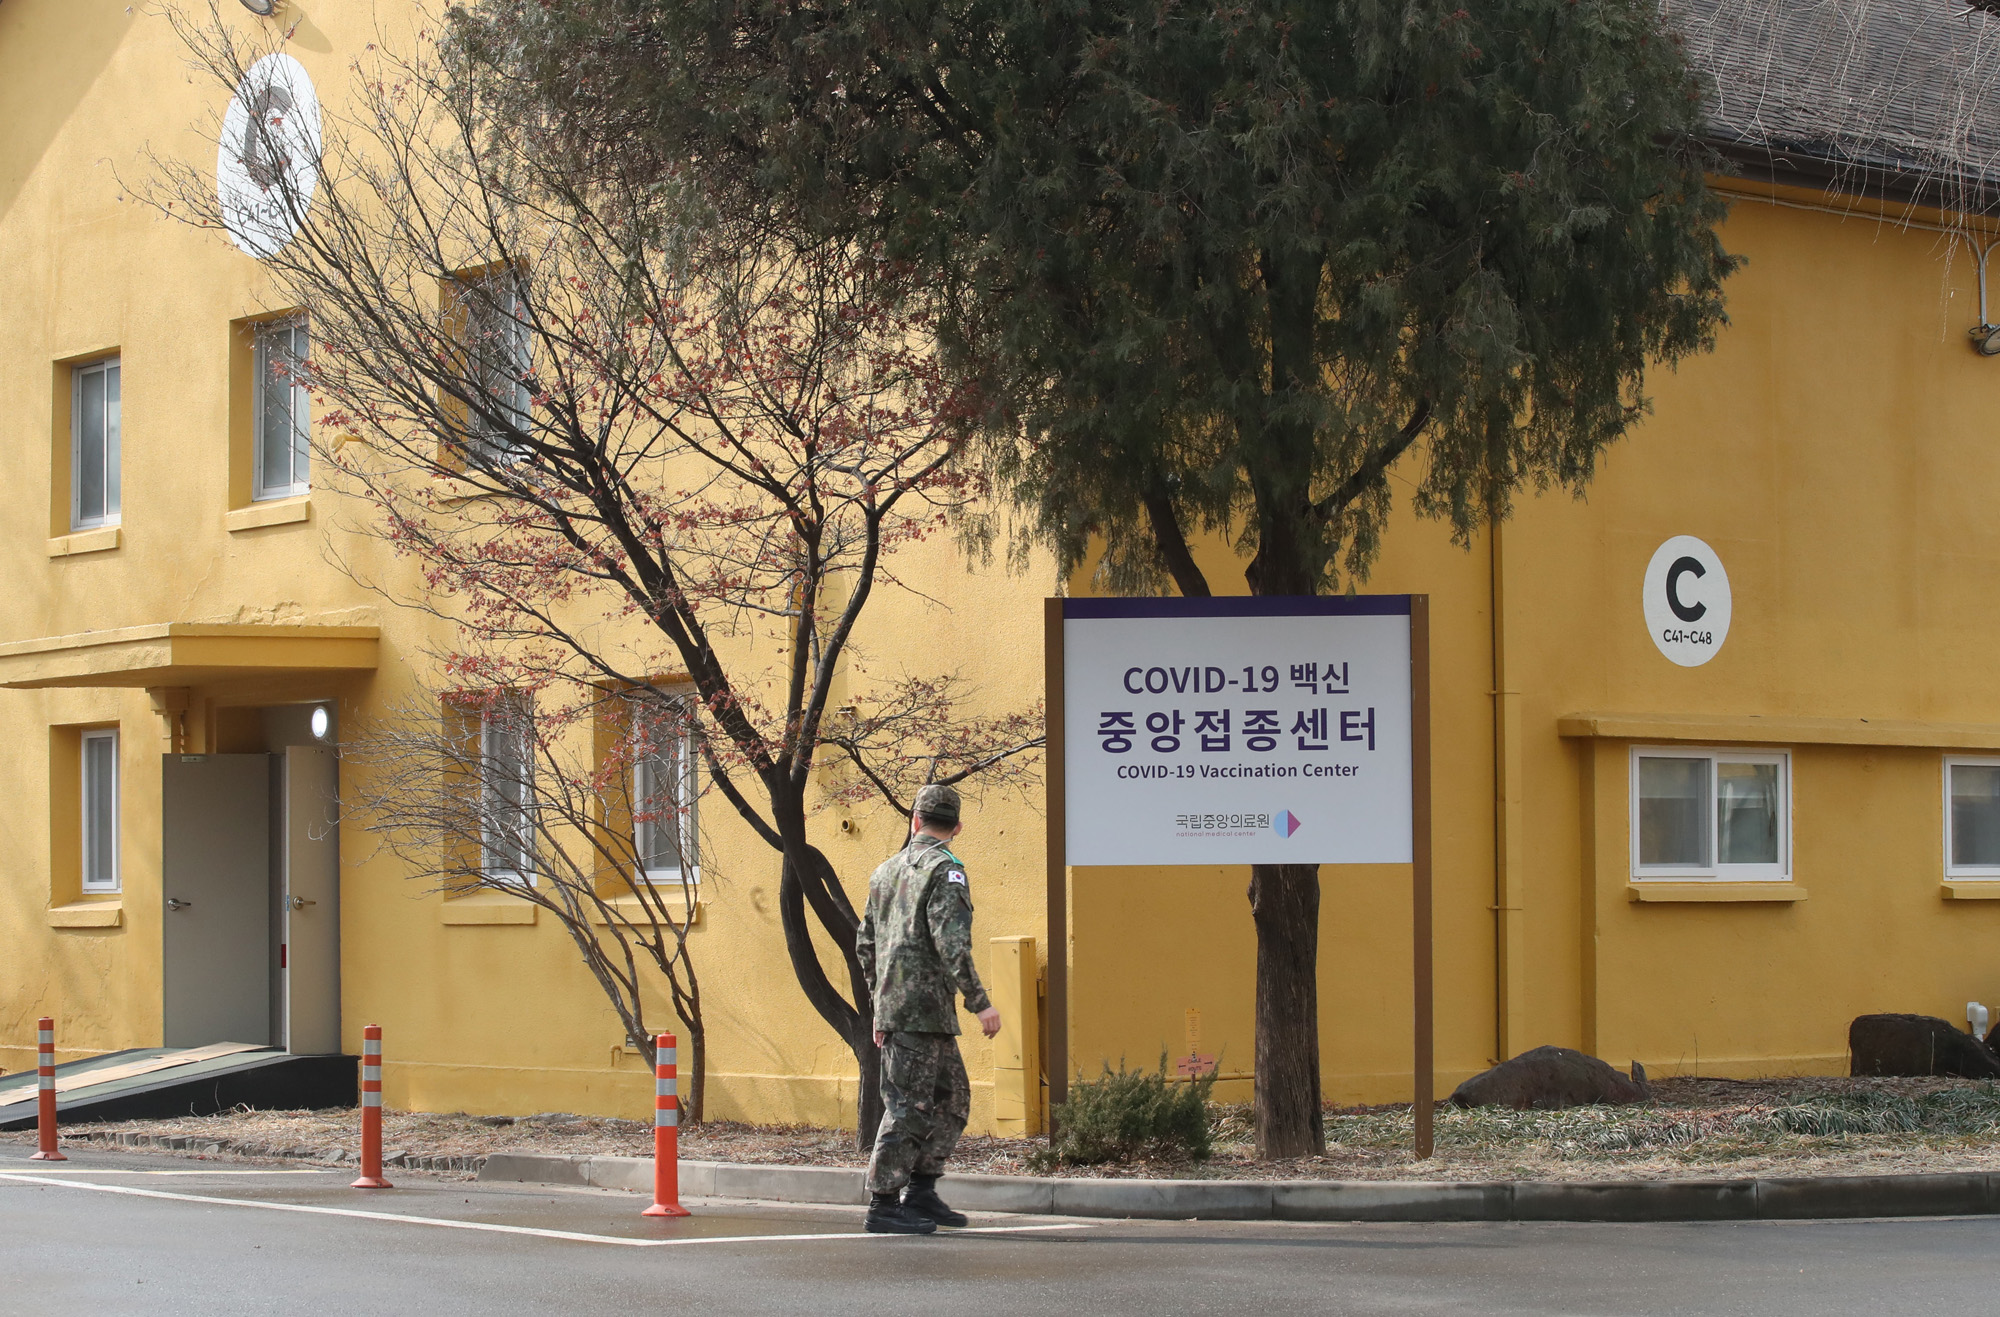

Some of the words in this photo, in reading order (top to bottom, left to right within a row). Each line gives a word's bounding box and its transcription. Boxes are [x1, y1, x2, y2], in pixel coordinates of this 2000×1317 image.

[244, 86, 293, 188] C
[1666, 556, 1707, 622] C
[1663, 629, 1712, 645] C41~C48
[1124, 666, 1280, 694] COVID-19
[1290, 662, 1350, 695] 백신
[1098, 707, 1376, 754] 중앙접종센터
[1117, 765, 1195, 779] COVID-19
[1200, 763, 1298, 778] Vaccination
[1303, 764, 1360, 777] Center
[1175, 813, 1270, 829] 국립중앙의료원
